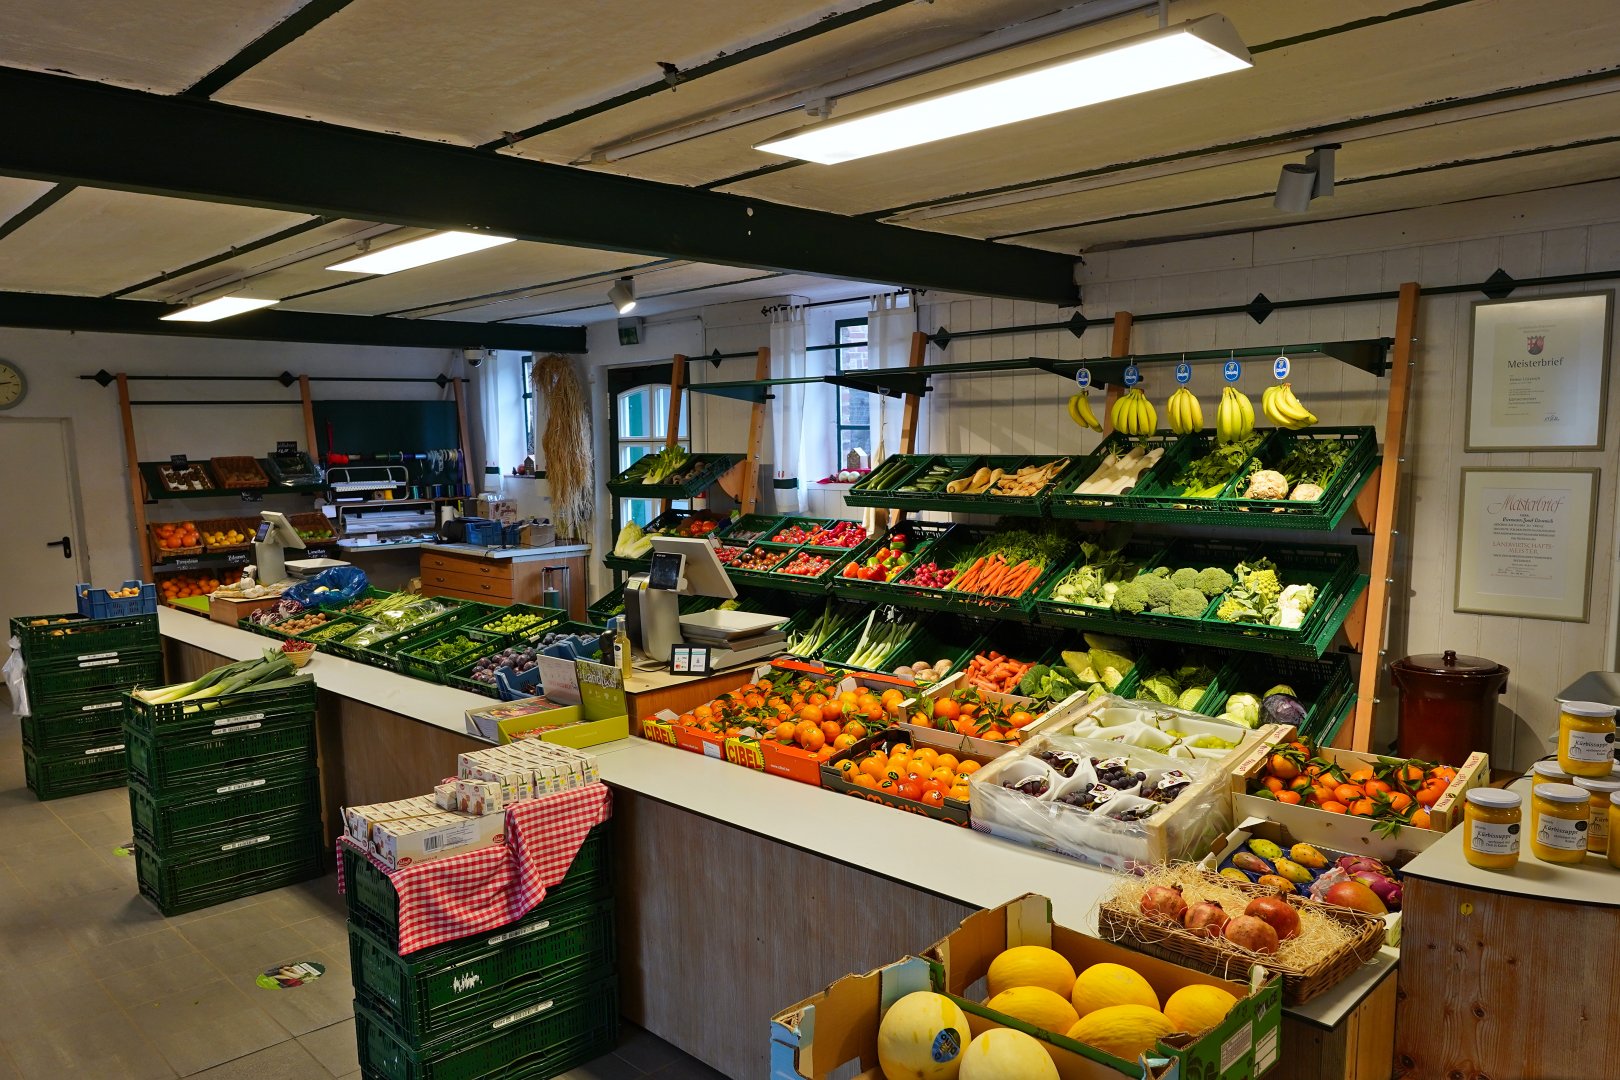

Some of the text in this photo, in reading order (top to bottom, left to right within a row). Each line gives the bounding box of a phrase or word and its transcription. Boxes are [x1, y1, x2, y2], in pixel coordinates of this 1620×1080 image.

[1507, 357, 1564, 368] Meisterbrief
[645, 725, 675, 745] CIBEL
[728, 745, 761, 769] CIBEL
